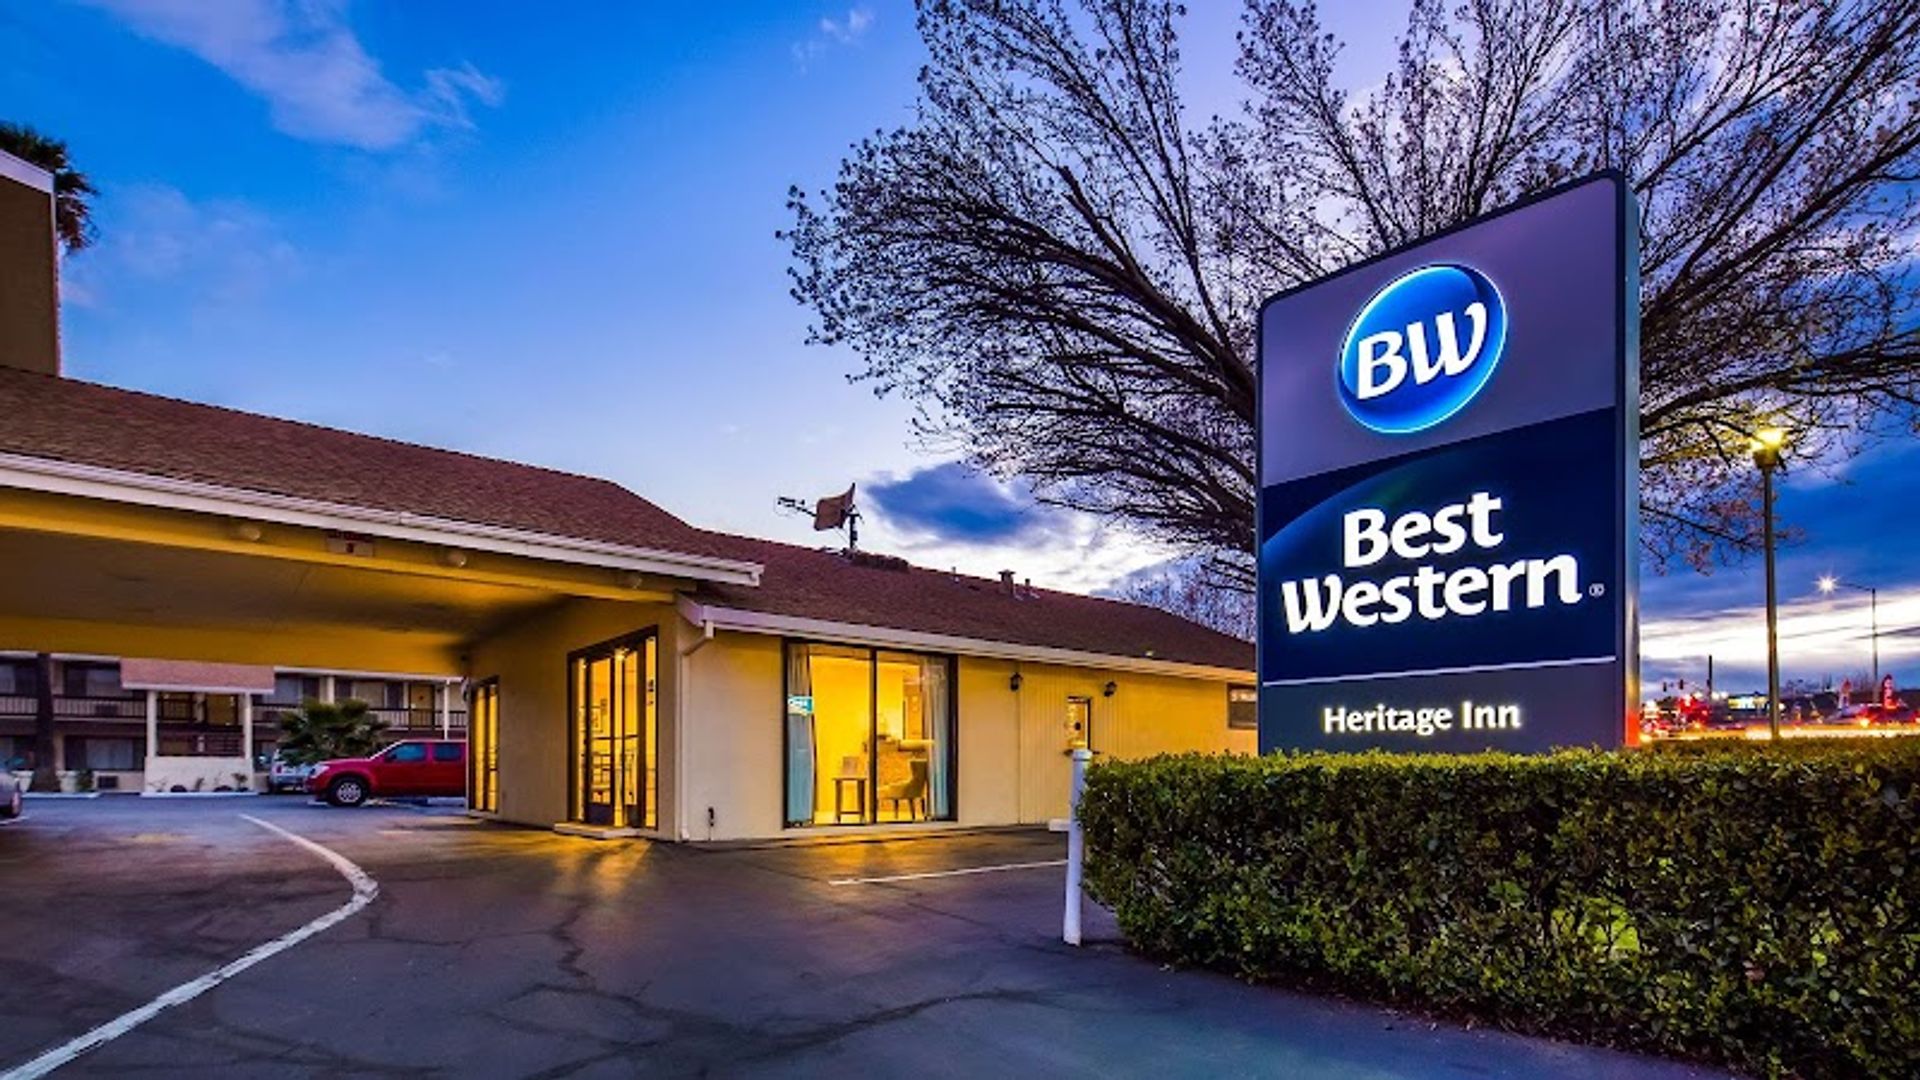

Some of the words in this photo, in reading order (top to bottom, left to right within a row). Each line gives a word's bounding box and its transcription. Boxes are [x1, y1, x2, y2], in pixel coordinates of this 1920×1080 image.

[1357, 302, 1487, 400] BW
[1343, 491, 1504, 568] Best
[1281, 553, 1583, 634] Western
[1323, 703, 1453, 737] Heritage
[1462, 700, 1522, 730] Inn
